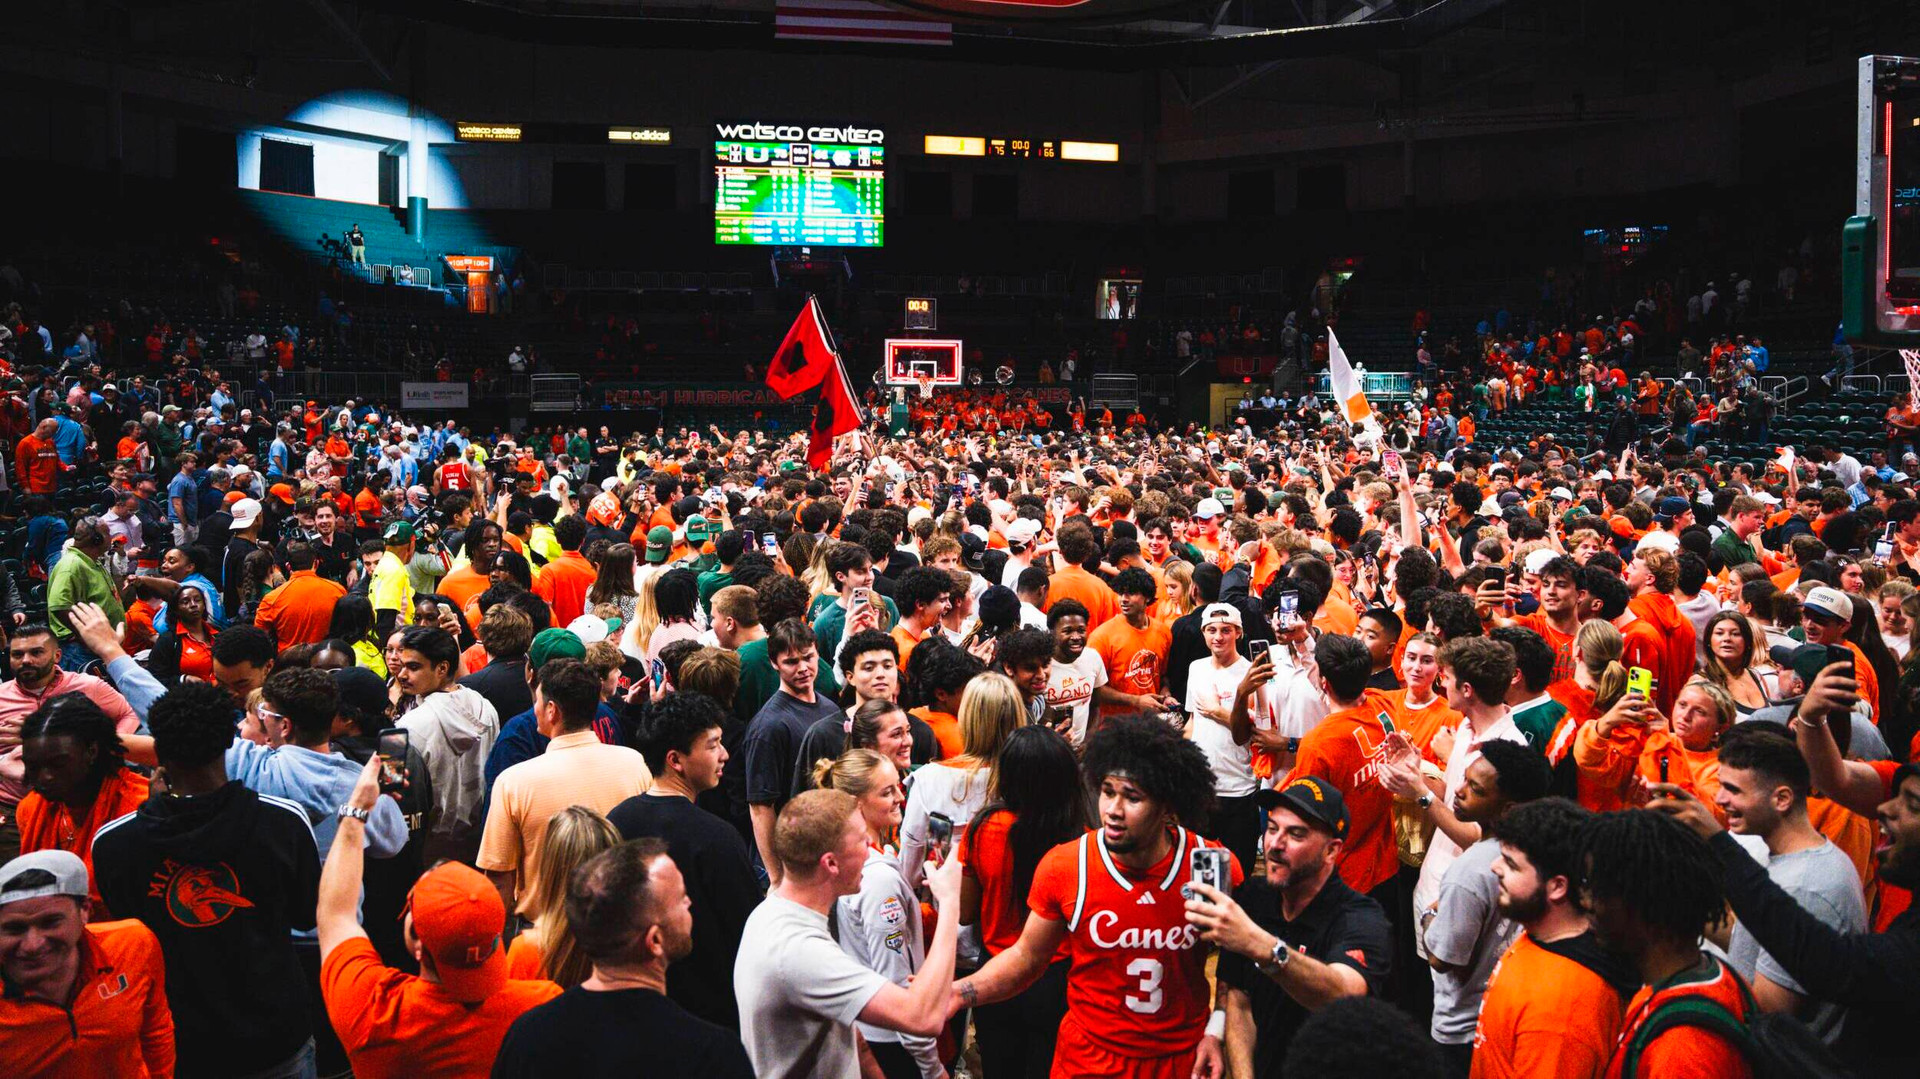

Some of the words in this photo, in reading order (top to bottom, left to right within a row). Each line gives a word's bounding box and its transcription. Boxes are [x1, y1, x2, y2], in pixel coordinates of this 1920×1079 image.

[632, 130, 670, 141] adidas
[1043, 147, 1054, 158] 66
[674, 389, 805, 406] HURRICANS
[1088, 909, 1201, 951] Canes
[97, 973, 128, 999] U
[1125, 957, 1164, 1014] 3
